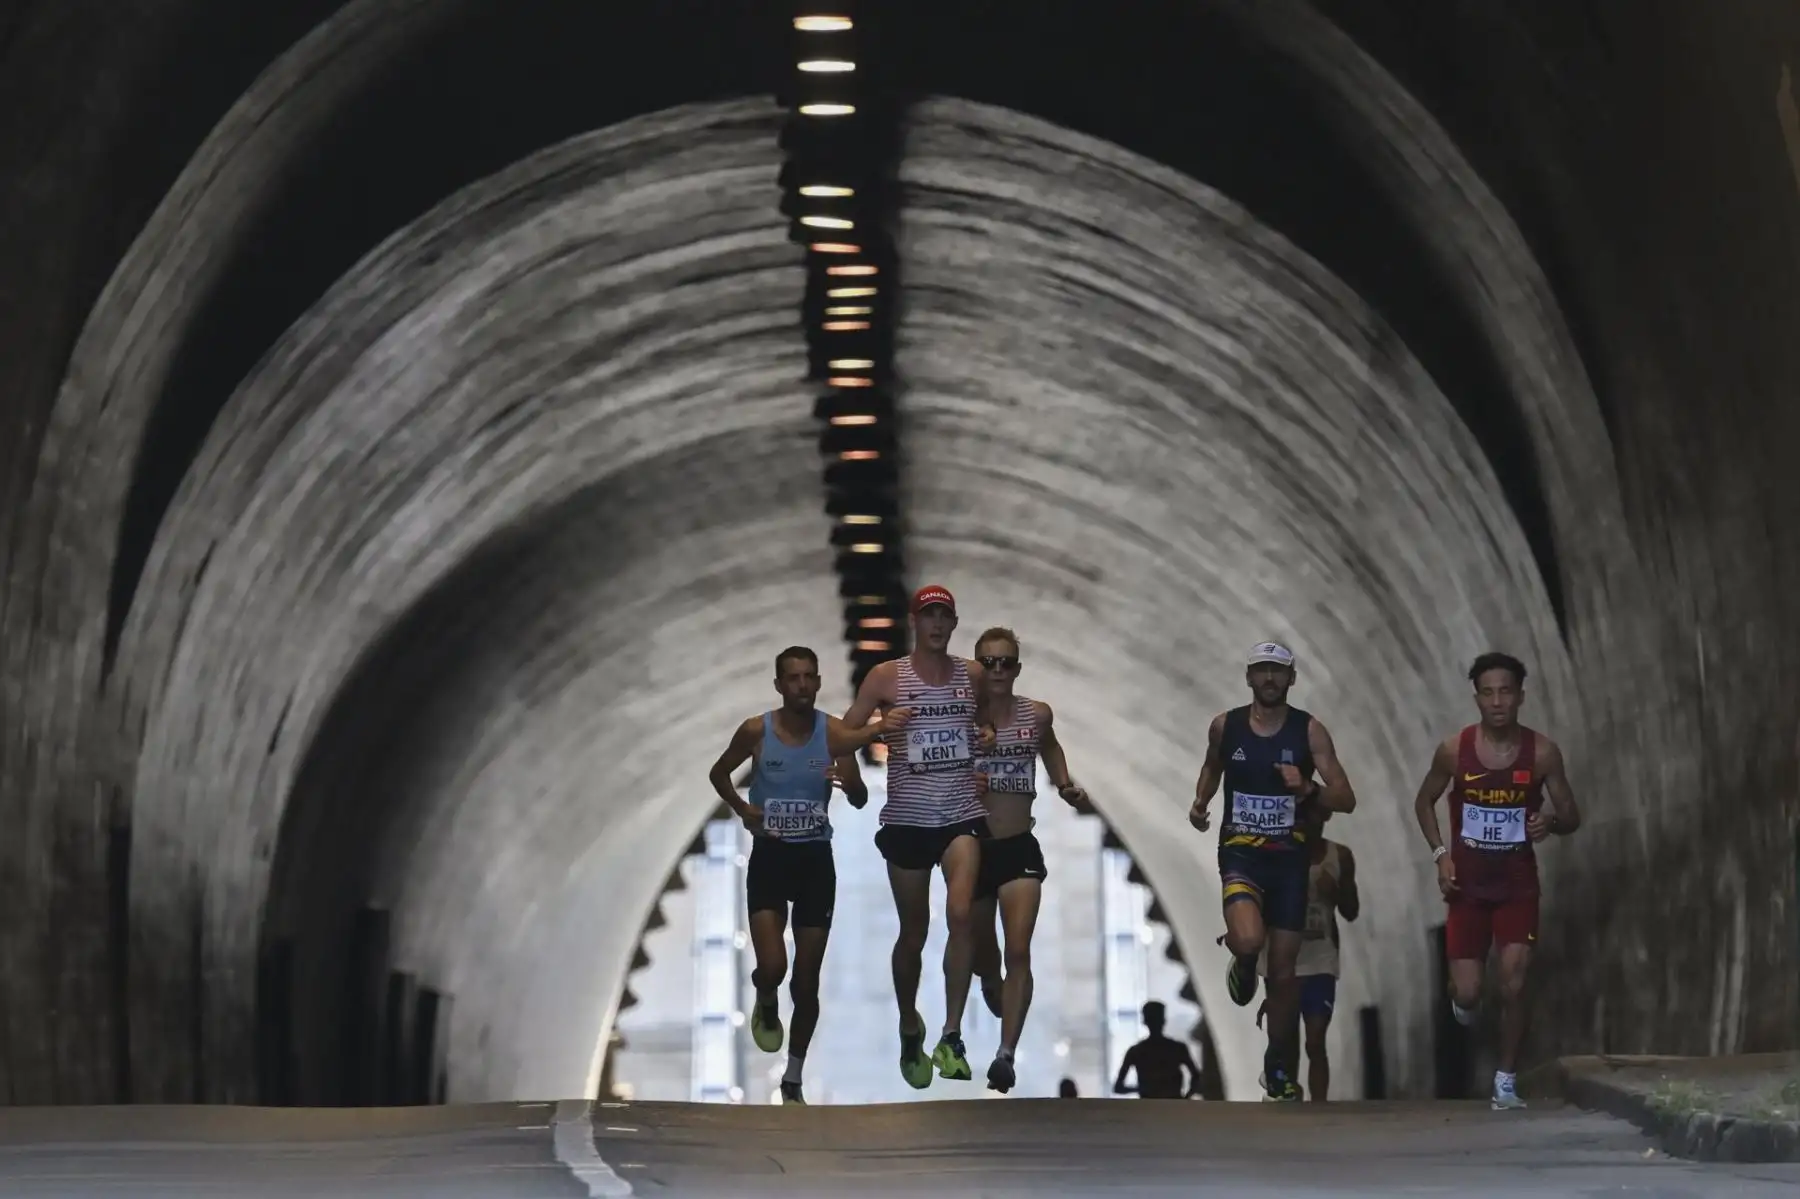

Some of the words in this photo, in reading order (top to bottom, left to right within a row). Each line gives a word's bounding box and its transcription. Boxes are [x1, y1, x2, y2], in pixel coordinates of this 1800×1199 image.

[920, 592, 951, 601] CANADA
[911, 705, 967, 717] CANADA
[924, 728, 964, 743] TDK
[922, 745, 957, 760] KENT
[990, 761, 1029, 774] TDK
[990, 777, 1030, 791] EISNER
[1246, 796, 1289, 810] TDK
[1464, 788, 1525, 804] CHINA
[781, 801, 821, 813] TDK
[768, 815, 825, 829] CUESTAS
[1240, 811, 1286, 825] SOARE
[1480, 809, 1521, 823] TDK
[1483, 826, 1502, 840] HE
